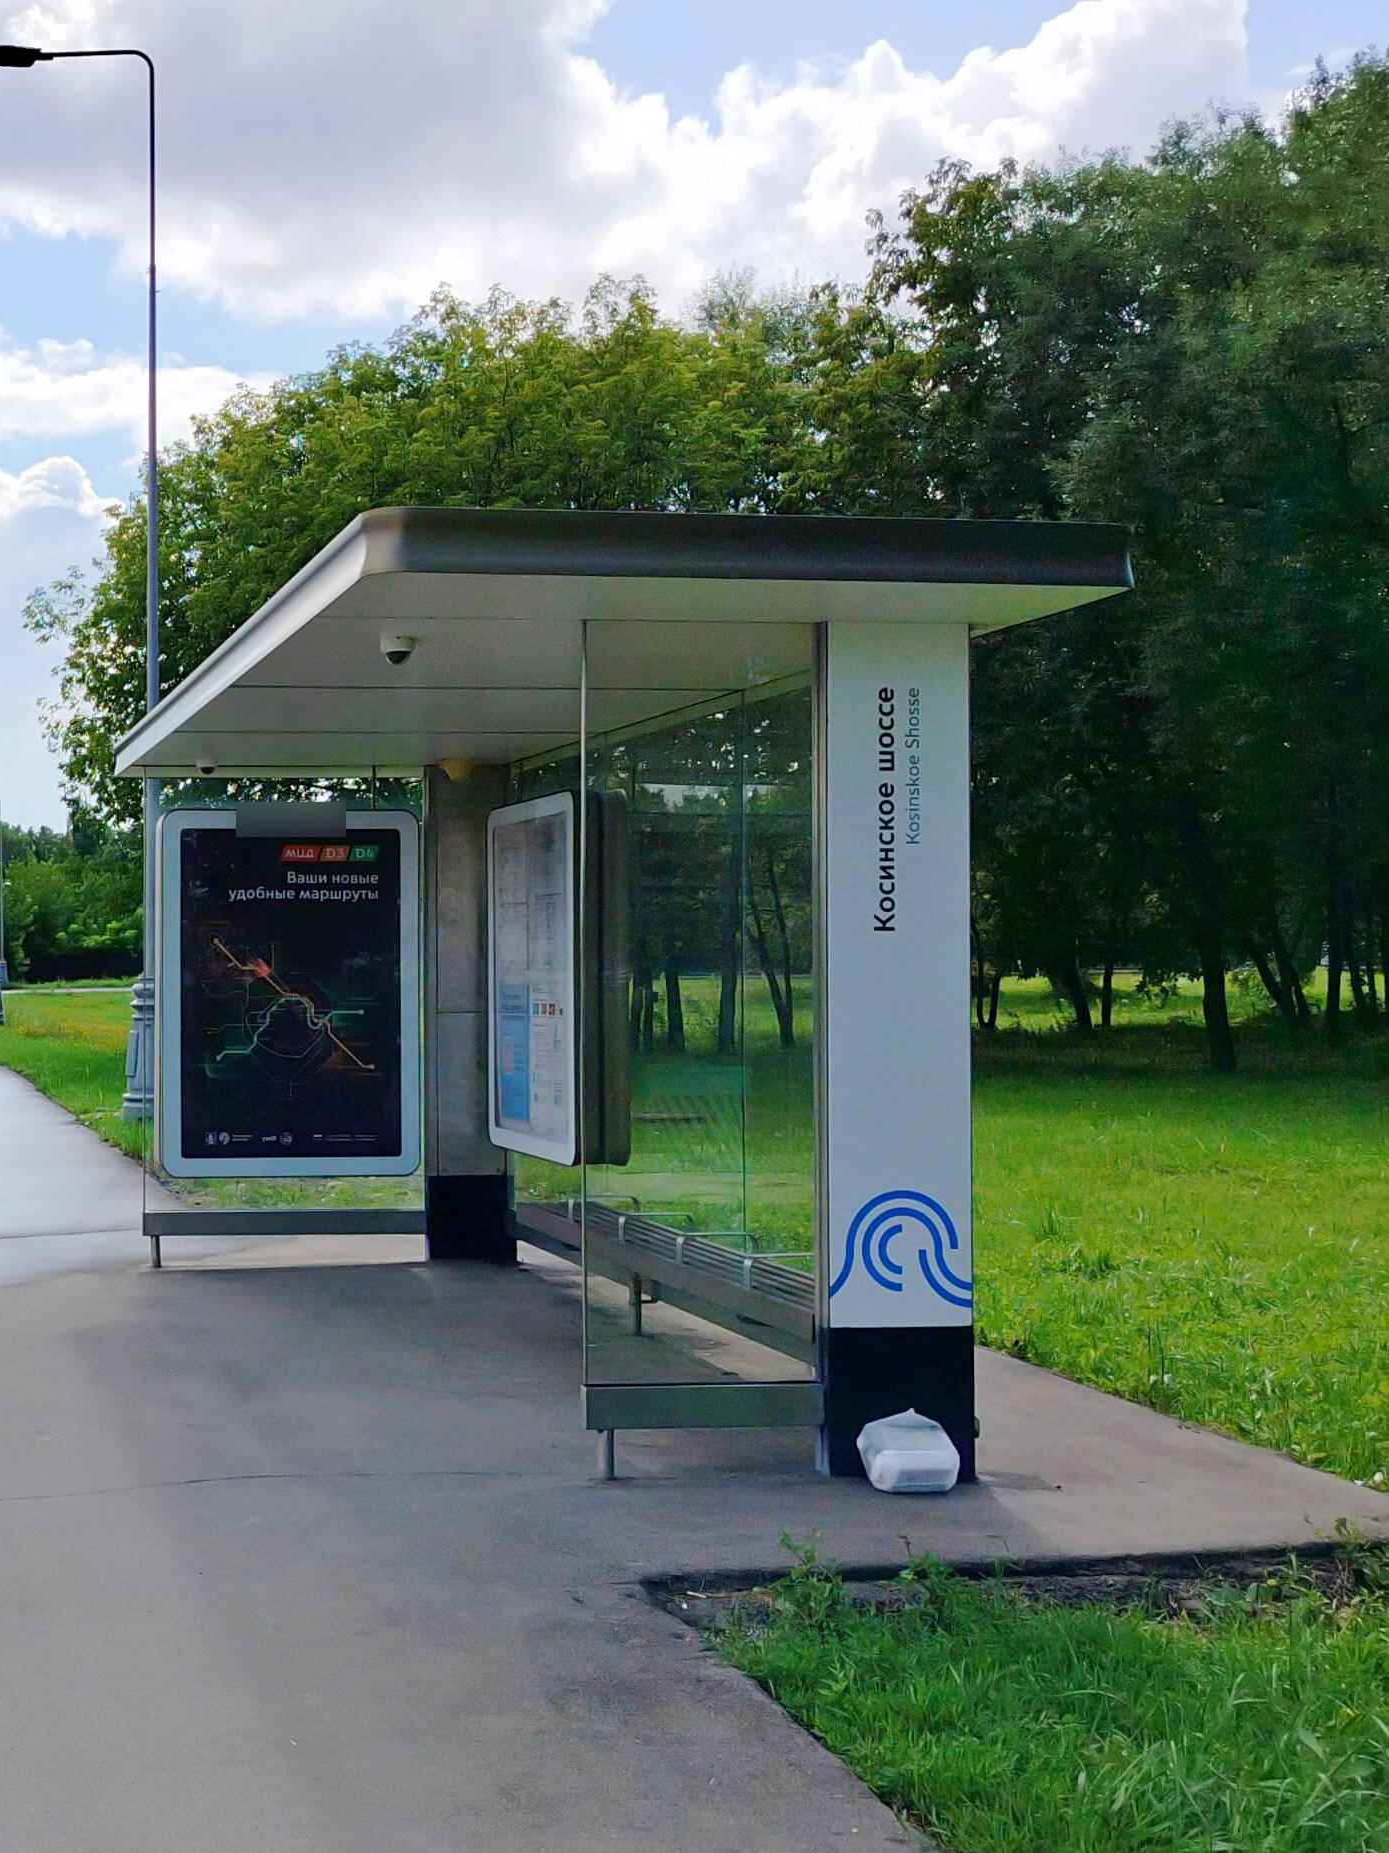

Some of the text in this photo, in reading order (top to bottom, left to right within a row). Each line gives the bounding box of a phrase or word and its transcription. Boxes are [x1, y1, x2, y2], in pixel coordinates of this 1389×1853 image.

[904, 687, 920, 845] Kosinskoe Shosse
[873, 687, 896, 932] Косинское шоссе
[326, 848, 374, 860] D3 D4
[287, 870, 379, 884] Ваши новые
[228, 886, 379, 902] удобные маршруты
